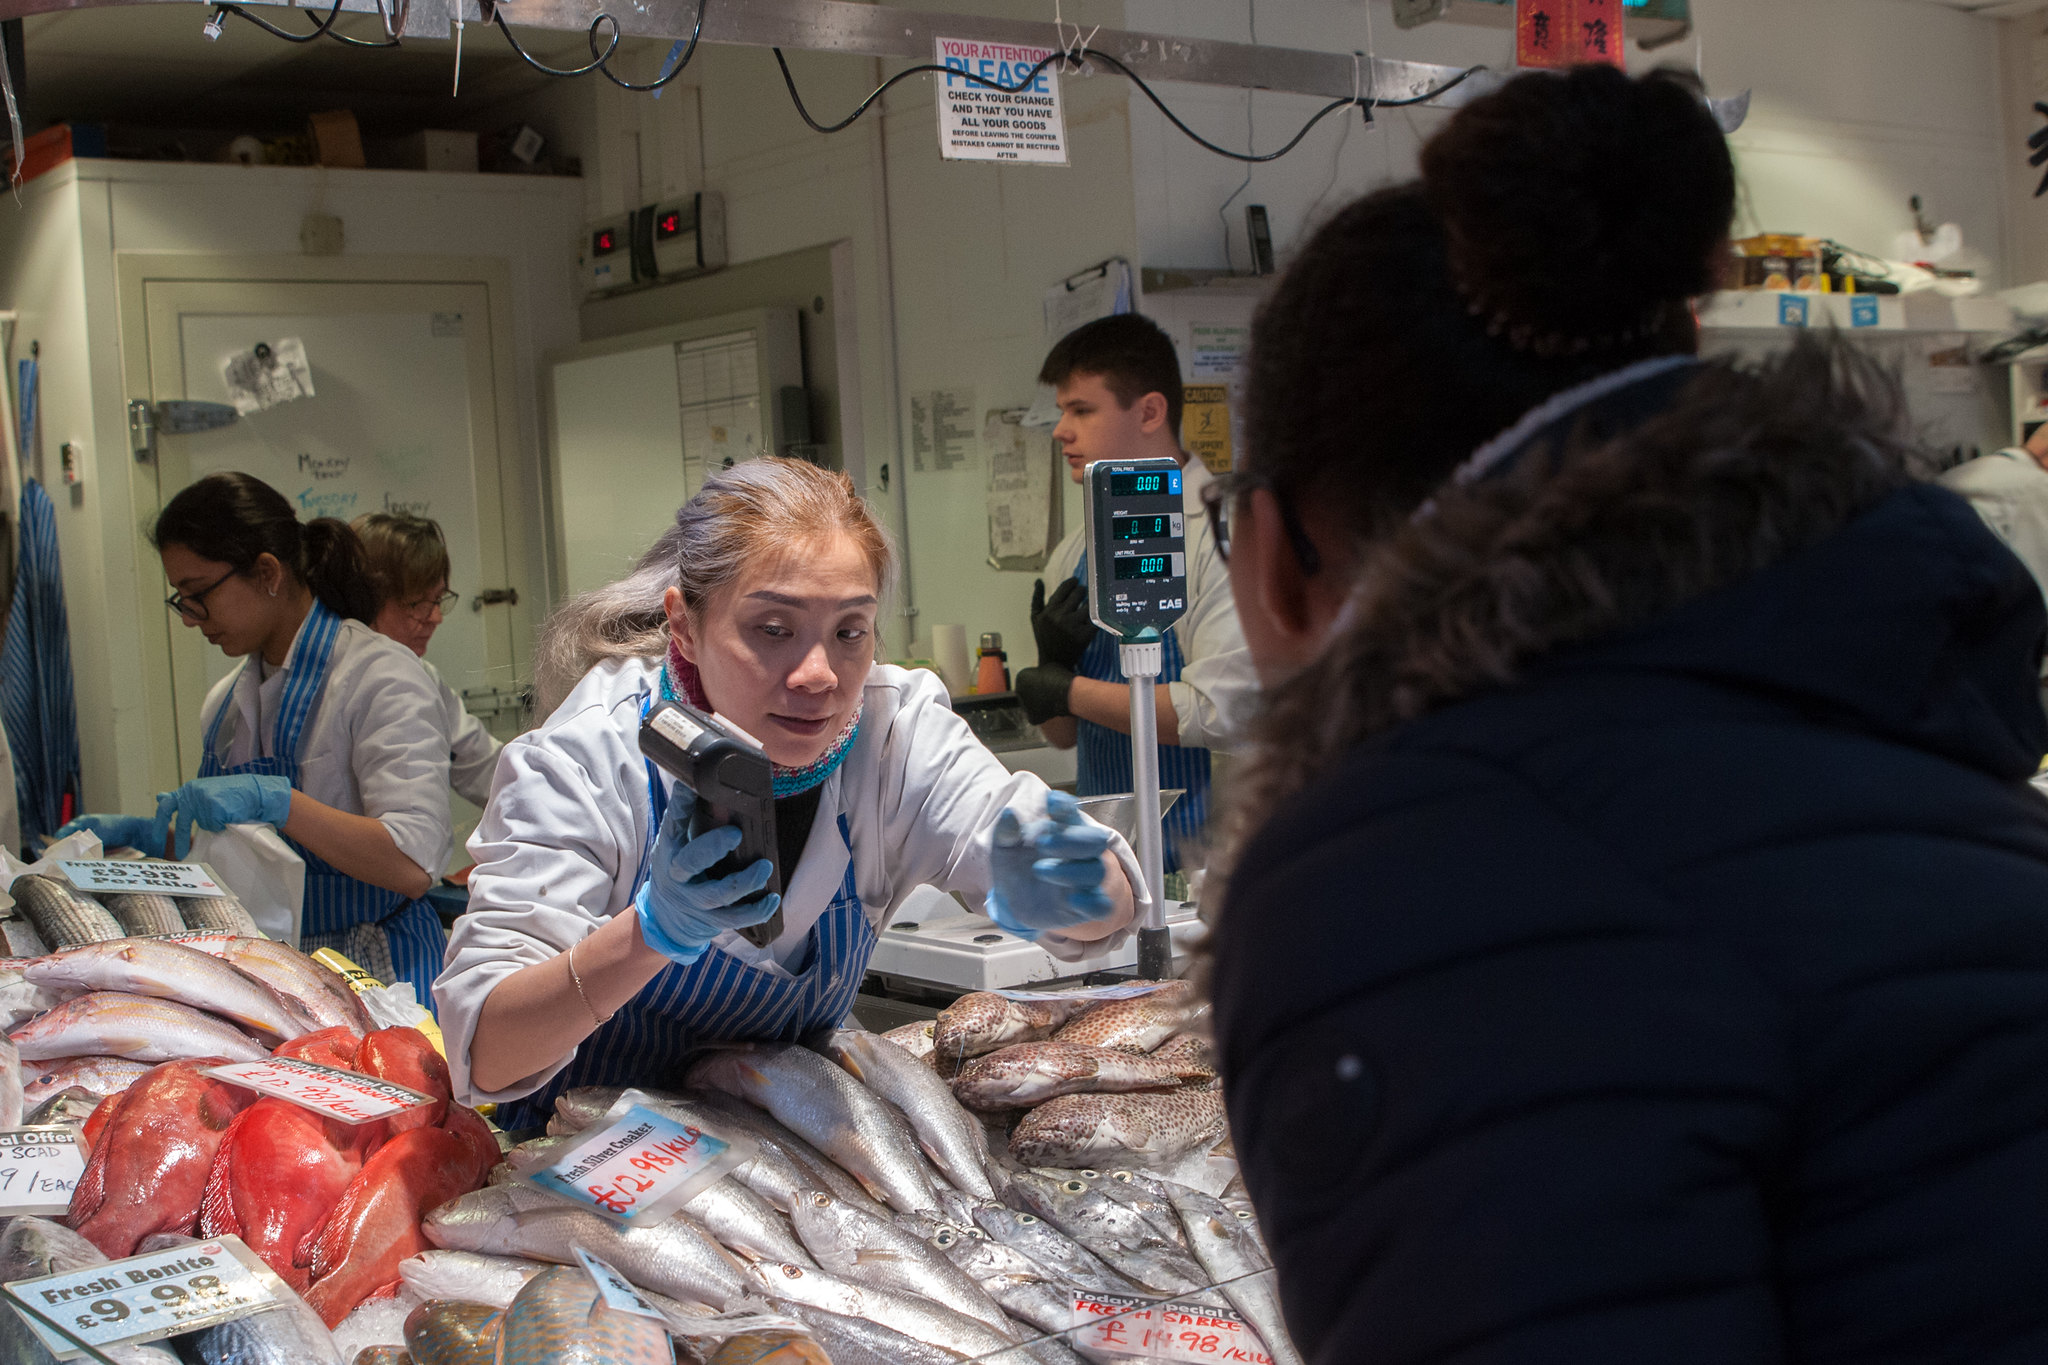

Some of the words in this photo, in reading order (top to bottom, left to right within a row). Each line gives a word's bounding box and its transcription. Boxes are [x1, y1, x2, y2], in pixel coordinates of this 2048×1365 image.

[942, 41, 981, 58] YOUR
[982, 45, 1050, 63] ATTENTION
[944, 57, 1050, 94] PLEASE
[948, 91, 982, 102] CHECK
[985, 93, 1012, 103] YOUR
[1014, 95, 1054, 106] CHANGE
[952, 104, 973, 114] AND
[976, 106, 1001, 115] THAT
[1003, 107, 1024, 116] YOU
[1027, 108, 1053, 118] HAVE
[961, 117, 979, 127] ALL
[982, 119, 1010, 128] YOUR
[1012, 120, 1046, 130] GOODS
[952, 129, 979, 137] BEFORE
[980, 131, 1009, 139] LEAVING
[1025, 133, 1057, 141] COUNTER
[951, 139, 985, 147] MISTAKES
[986, 141, 1014, 149] CANNOT
[1026, 143, 1060, 151] RECTIFIED
[1137, 476, 1160, 491] 0.00
[1172, 478, 1179, 488] £
[1172, 521, 1182, 531] kg
[1141, 557, 1164, 573] 0.00
[1159, 598, 1182, 610] CAS
[92, 868, 181, 880] £9.98
[110, 862, 143, 870] Grey
[148, 863, 193, 872] Mullet
[90, 876, 138, 885] Per
[145, 878, 198, 889] Kilo
[327, 1070, 382, 1089] Special
[380, 1085, 420, 1103] Offer
[23, 1131, 74, 1144] Offer
[12, 1146, 61, 1159] SCAD
[554, 1163, 590, 1184] Fresh
[584, 1145, 617, 1168] Silver
[609, 1121, 654, 1151] Croaker
[28, 1170, 75, 1194] /EAC
[40, 1276, 121, 1304] Fresh
[125, 1255, 216, 1285] Bonito
[1073, 1289, 1147, 1309] Today's
[1164, 1303, 1223, 1318] pecial
[1163, 1311, 1243, 1332] SABRE
